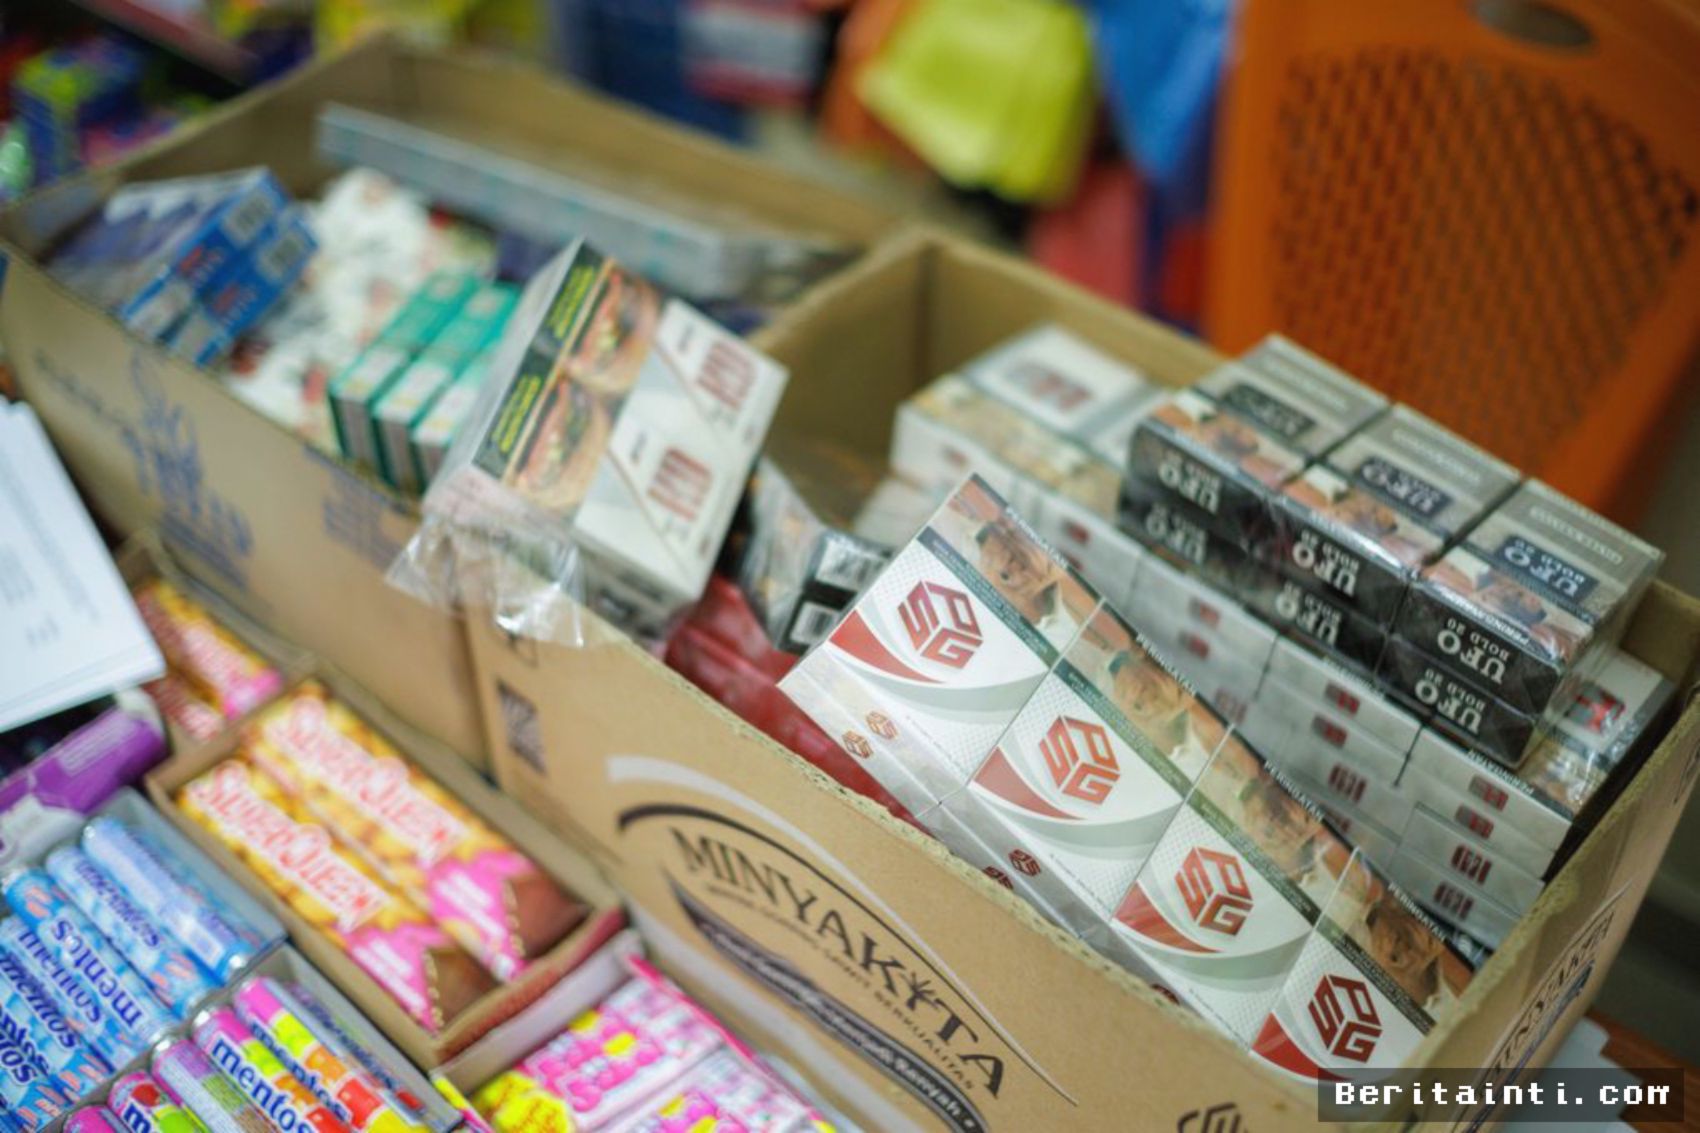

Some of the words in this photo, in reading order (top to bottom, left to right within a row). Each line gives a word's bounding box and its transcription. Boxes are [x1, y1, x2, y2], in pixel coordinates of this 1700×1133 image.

[1292, 539, 1357, 597] UFO
[1504, 545, 1581, 597] UFO
[1540, 553, 1585, 585] BOLD
[897, 580, 983, 669] PSG
[1275, 591, 1339, 646] UFO
[1447, 617, 1466, 635] 20
[1469, 631, 1510, 662] BOLD
[1136, 631, 1197, 696] PERINGATAN
[1436, 629, 1507, 684] UFO
[1414, 677, 1483, 735] UFO
[1447, 681, 1487, 713] BOLD
[1039, 714, 1121, 806] PSG
[1263, 760, 1326, 823] PERINGATAN
[1174, 846, 1254, 937] PSG
[1387, 881, 1449, 944] PERINGATAN
[51, 919, 142, 1028] mentos
[1308, 973, 1384, 1063] PSG
